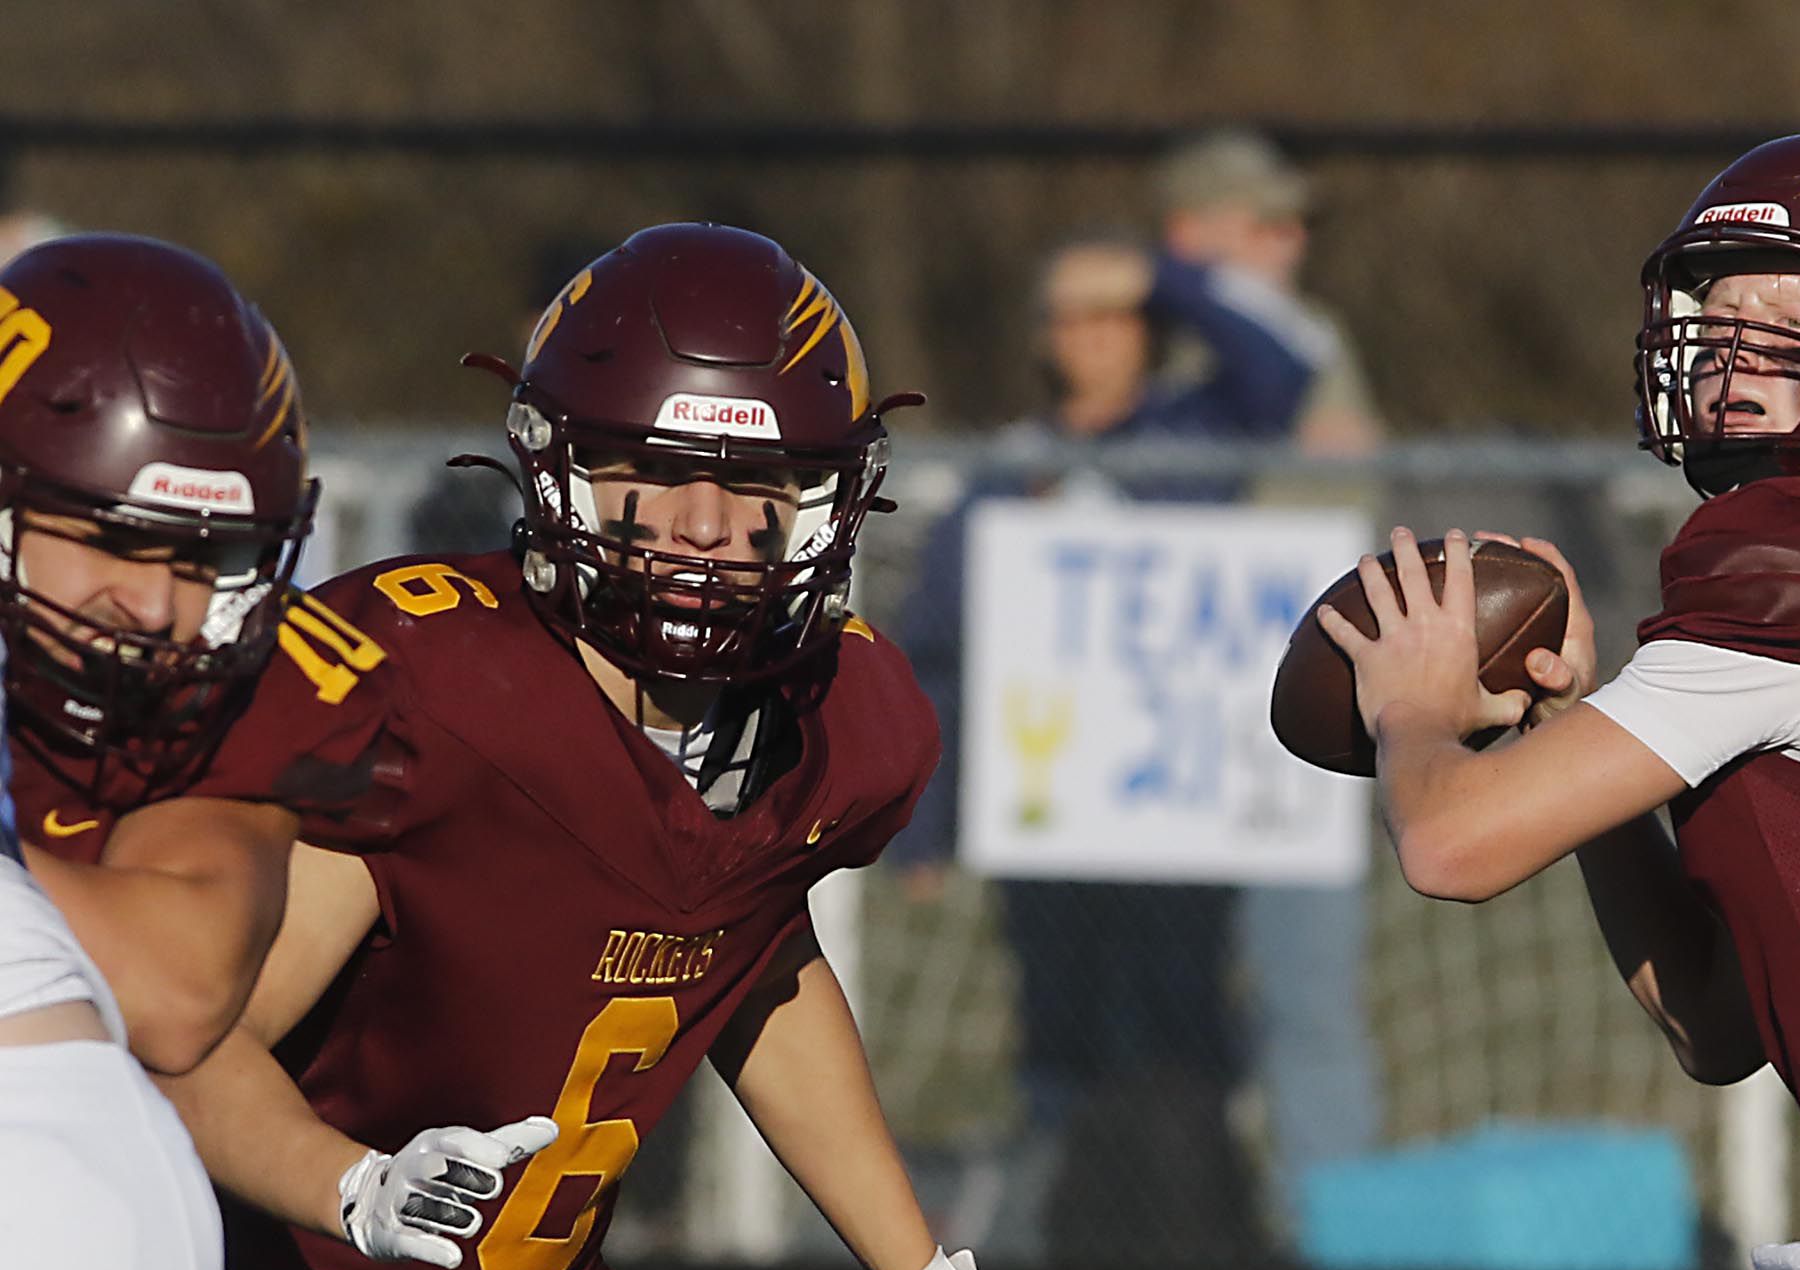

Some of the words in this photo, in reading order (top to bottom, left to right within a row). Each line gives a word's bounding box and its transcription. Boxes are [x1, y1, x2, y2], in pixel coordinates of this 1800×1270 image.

[1702, 206, 1775, 223] Riddell
[673, 401, 766, 427] Riddell
[372, 562, 500, 617] 6
[277, 591, 388, 705] 10
[591, 929, 725, 984] ROCKETS
